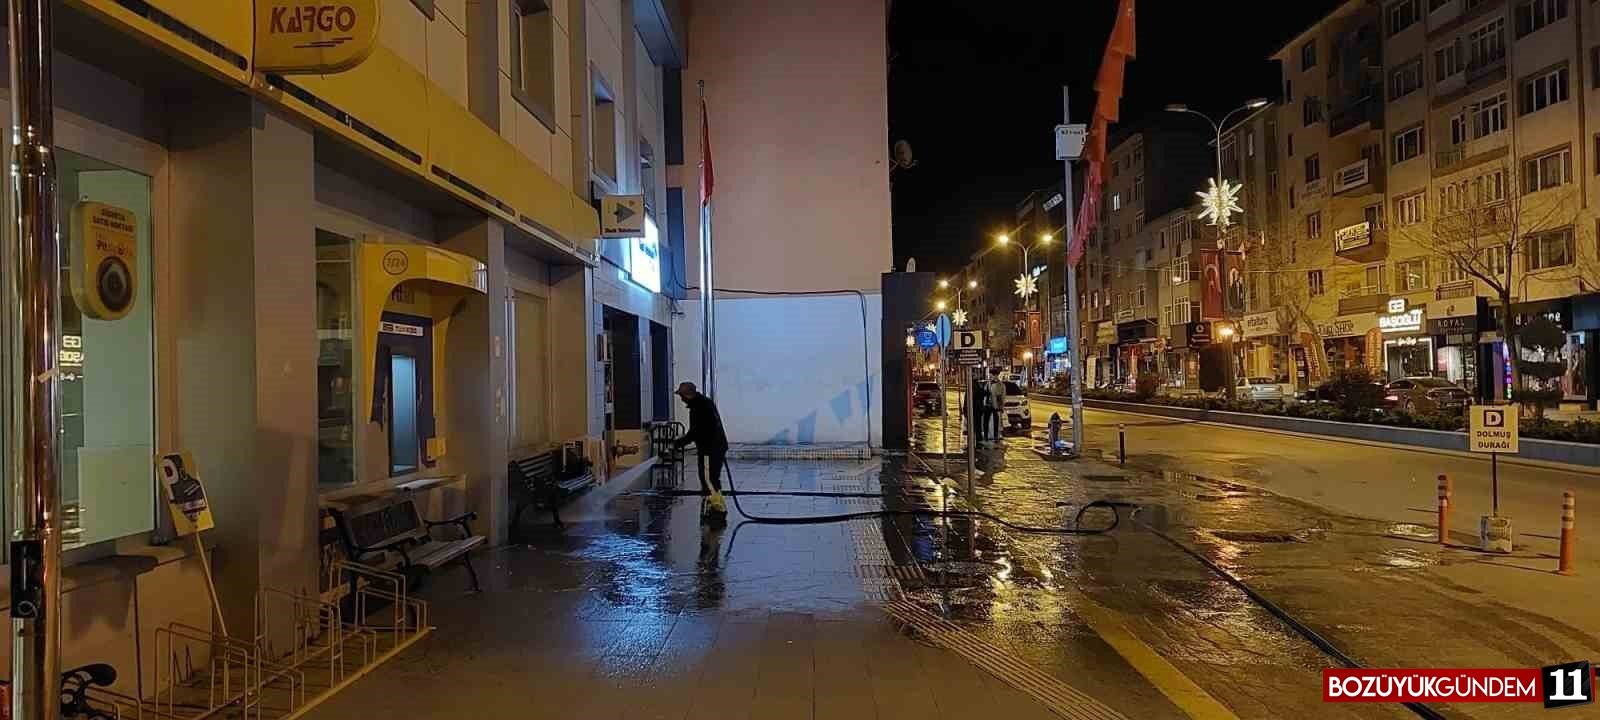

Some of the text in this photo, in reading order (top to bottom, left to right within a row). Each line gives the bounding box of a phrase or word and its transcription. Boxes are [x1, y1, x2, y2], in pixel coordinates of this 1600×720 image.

[270, 6, 356, 33] KARGO
[961, 332, 976, 348] D
[1486, 411, 1502, 426] D
[1476, 431, 1511, 439] DOLMUŞ
[1478, 441, 1510, 449] DURAĞI
